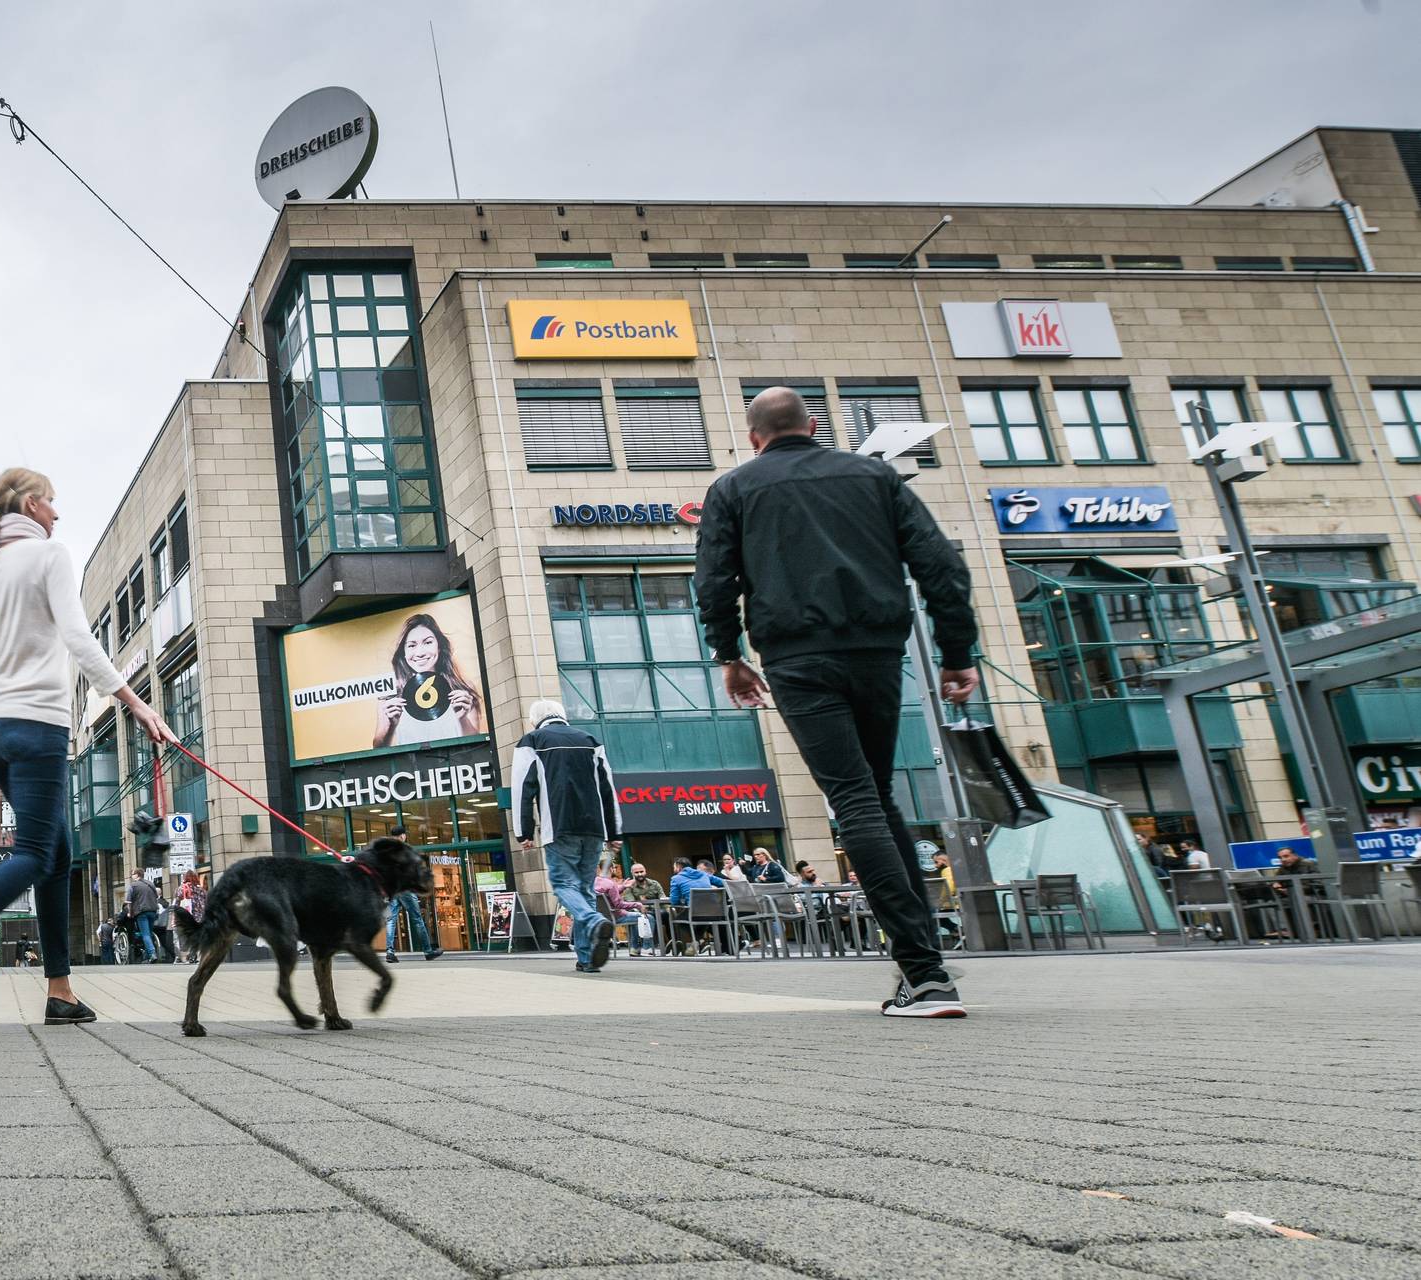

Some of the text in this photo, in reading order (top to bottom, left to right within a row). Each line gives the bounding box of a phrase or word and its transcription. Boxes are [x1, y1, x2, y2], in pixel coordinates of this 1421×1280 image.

[260, 117, 364, 178] DREHSCHEIBE
[574, 320, 679, 339] Postbank
[1018, 306, 1062, 346] kik
[551, 503, 676, 526] NORDSEE
[1065, 496, 1172, 524] Tchibo
[294, 677, 395, 707] WILLKOMMEN
[303, 762, 493, 811] DREHSCHEIBE
[678, 800, 771, 816] DER SNACK PROFI.
[1356, 838, 1387, 850] um
